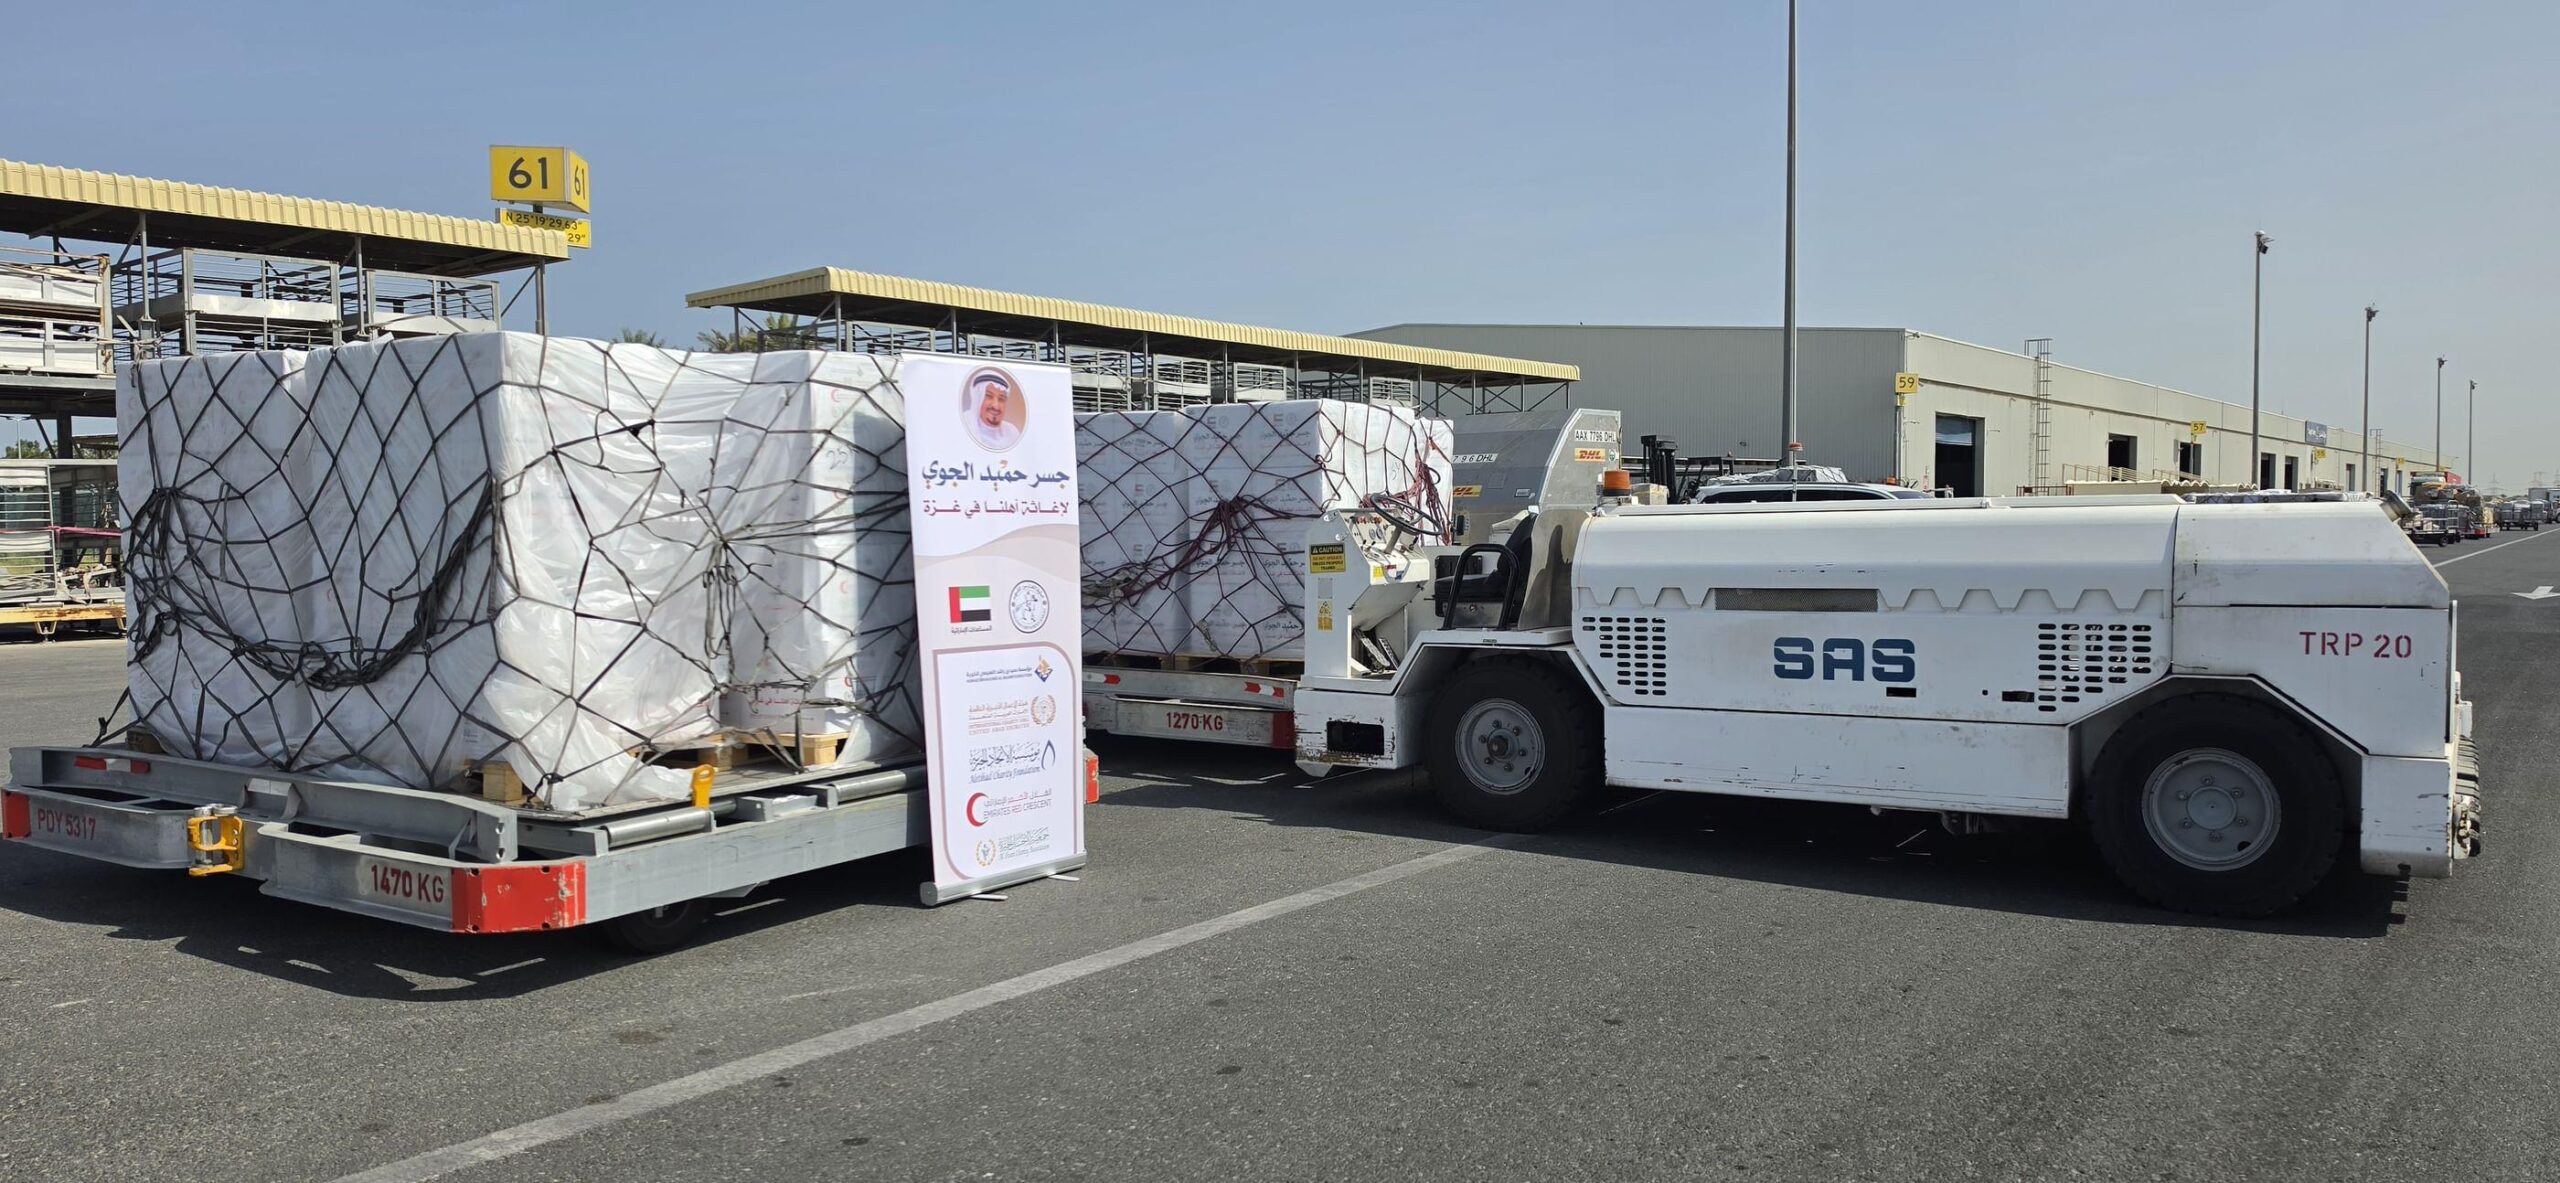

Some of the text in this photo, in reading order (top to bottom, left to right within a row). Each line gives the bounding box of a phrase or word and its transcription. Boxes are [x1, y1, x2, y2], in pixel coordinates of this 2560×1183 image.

[508, 156, 548, 189] 61
[574, 165, 586, 200] 61
[506, 212, 514, 221] N
[1899, 377, 1915, 389] 59
[2193, 422, 2204, 431] 57
[1575, 430, 1588, 441] AAX
[1604, 431, 1616, 443] DHL
[1476, 454, 1494, 462] DHL
[1579, 450, 1602, 460] DHL
[922, 460, 974, 490] الجوي
[923, 499, 962, 517] غزة
[965, 500, 981, 519] في
[1318, 546, 1343, 554] CAUTION
[2299, 631, 2413, 658] TRP 20
[1773, 636, 1916, 683] SAS
[1166, 711, 1224, 731] 1270 KG
[37, 808, 96, 840] PDY 5317
[371, 864, 444, 903] 1470 KG
